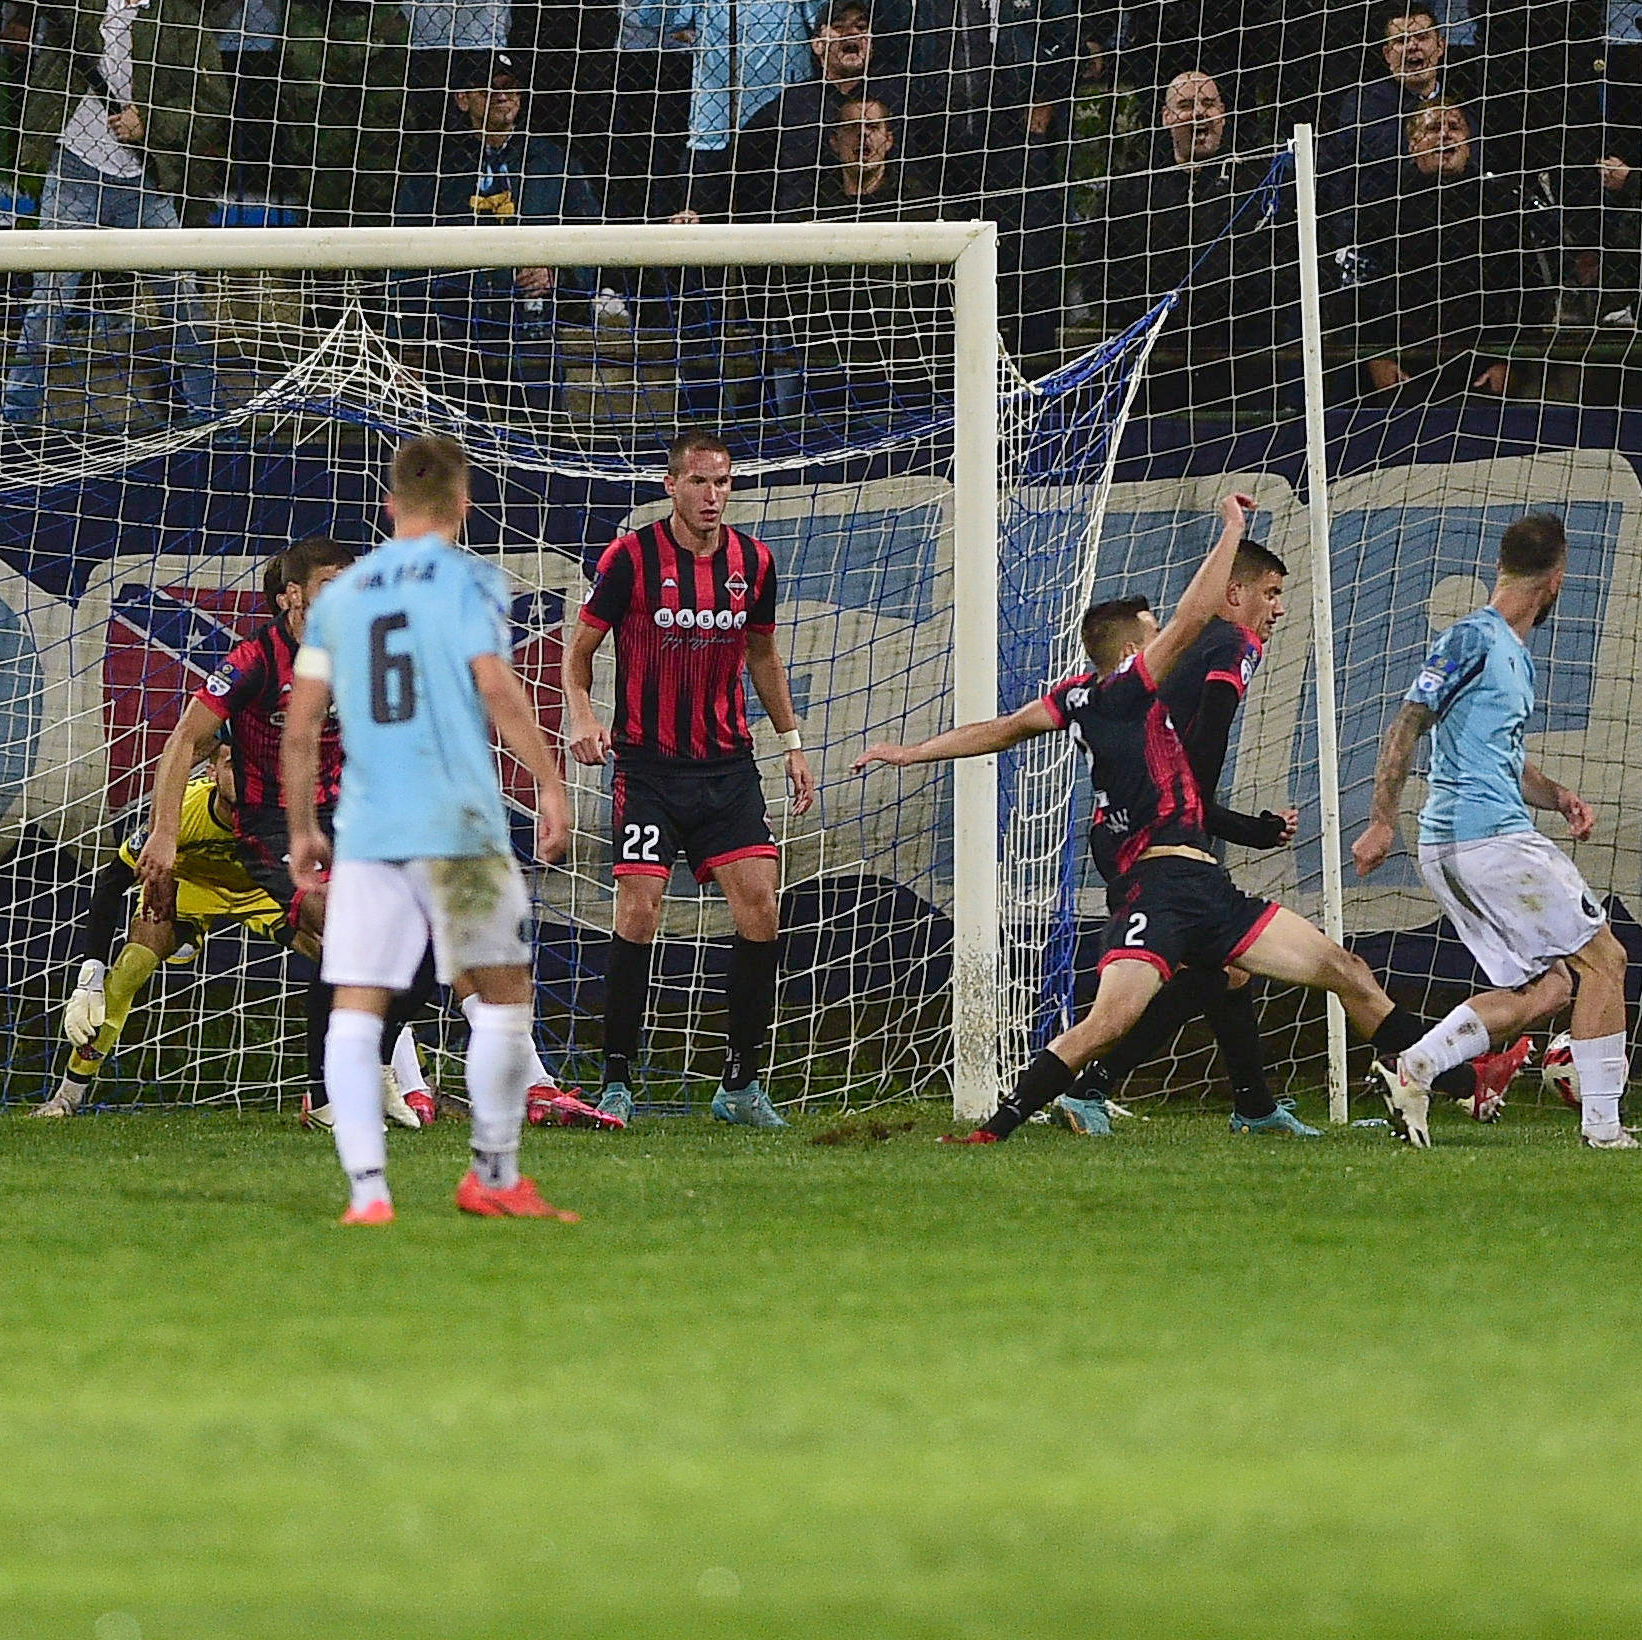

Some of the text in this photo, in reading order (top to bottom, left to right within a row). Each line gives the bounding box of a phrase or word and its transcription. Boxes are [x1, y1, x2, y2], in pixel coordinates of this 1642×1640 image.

[369, 609, 417, 725] 6
[622, 823, 660, 861] 22
[1123, 912, 1148, 947] 2
